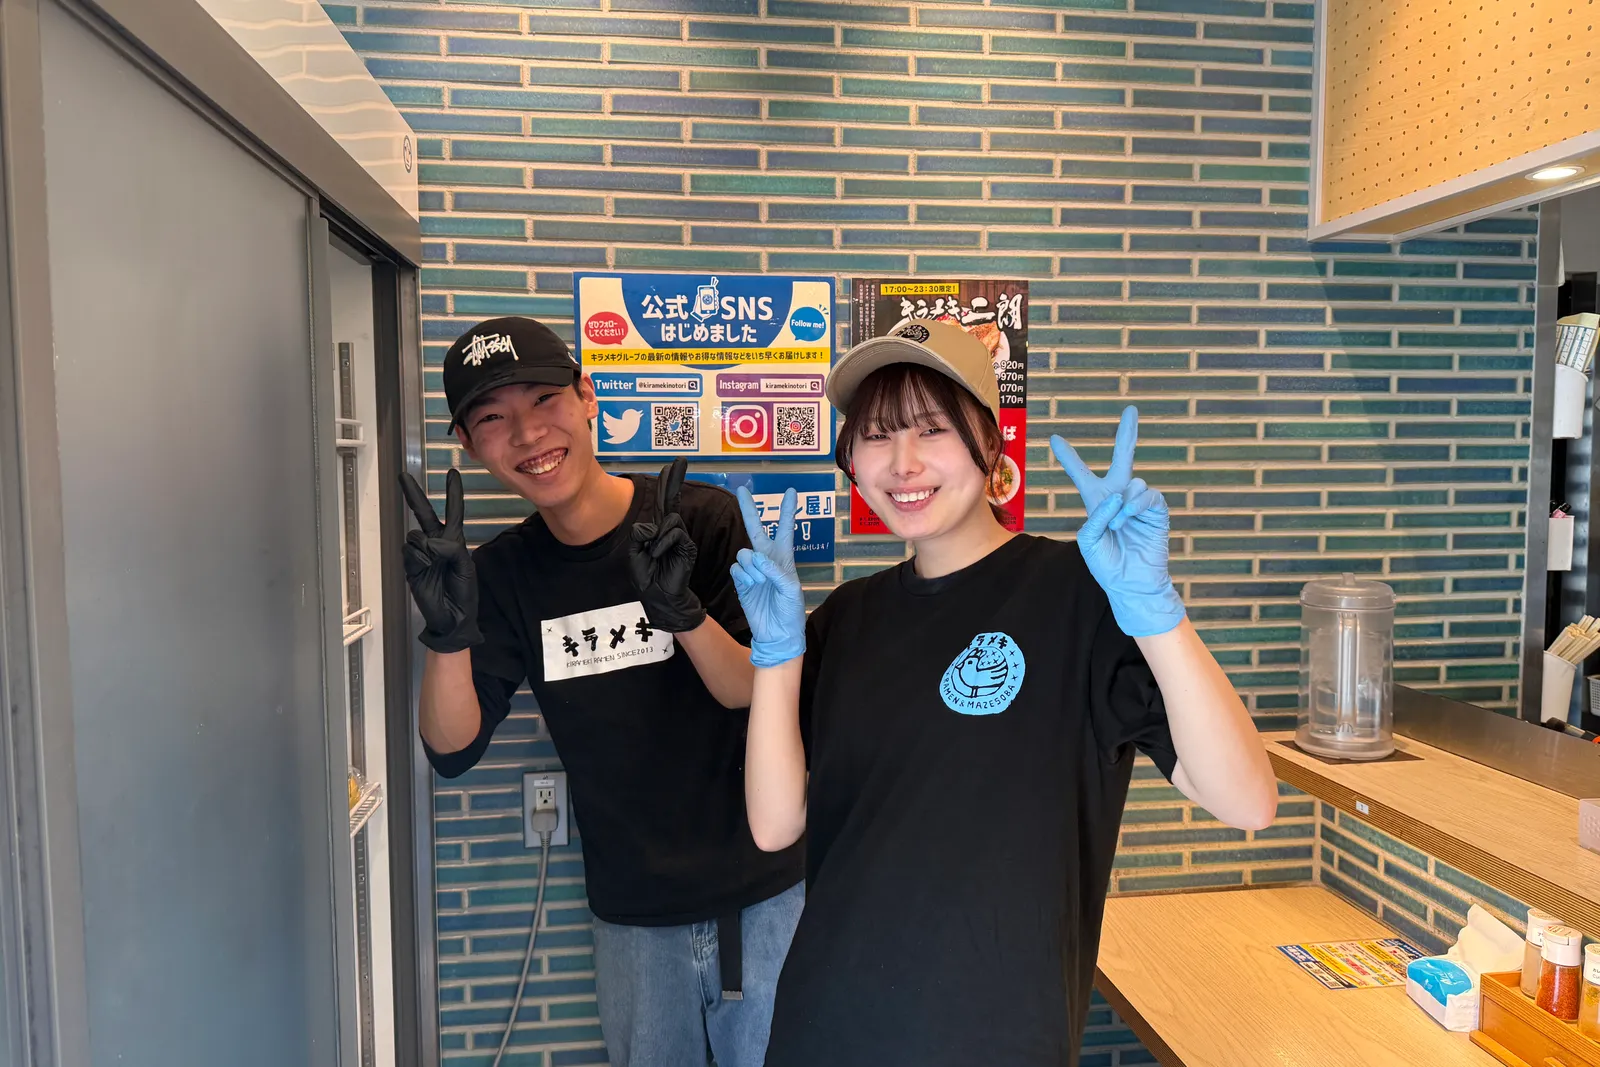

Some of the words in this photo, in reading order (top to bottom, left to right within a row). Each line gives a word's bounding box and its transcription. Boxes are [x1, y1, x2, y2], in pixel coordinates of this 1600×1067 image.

[641, 294, 689, 321] 公式
[720, 296, 774, 321] SNS
[588, 320, 618, 329] ぜひフォロー
[791, 319, 812, 328] Follow
[812, 321, 825, 329] me!
[661, 323, 757, 343] はじめました
[595, 380, 634, 390] Twitter
[638, 381, 687, 389] @kiramekinotori
[719, 380, 759, 392] Instagram
[562, 617, 654, 657] キラメキ
[594, 655, 615, 664] RAMEN
